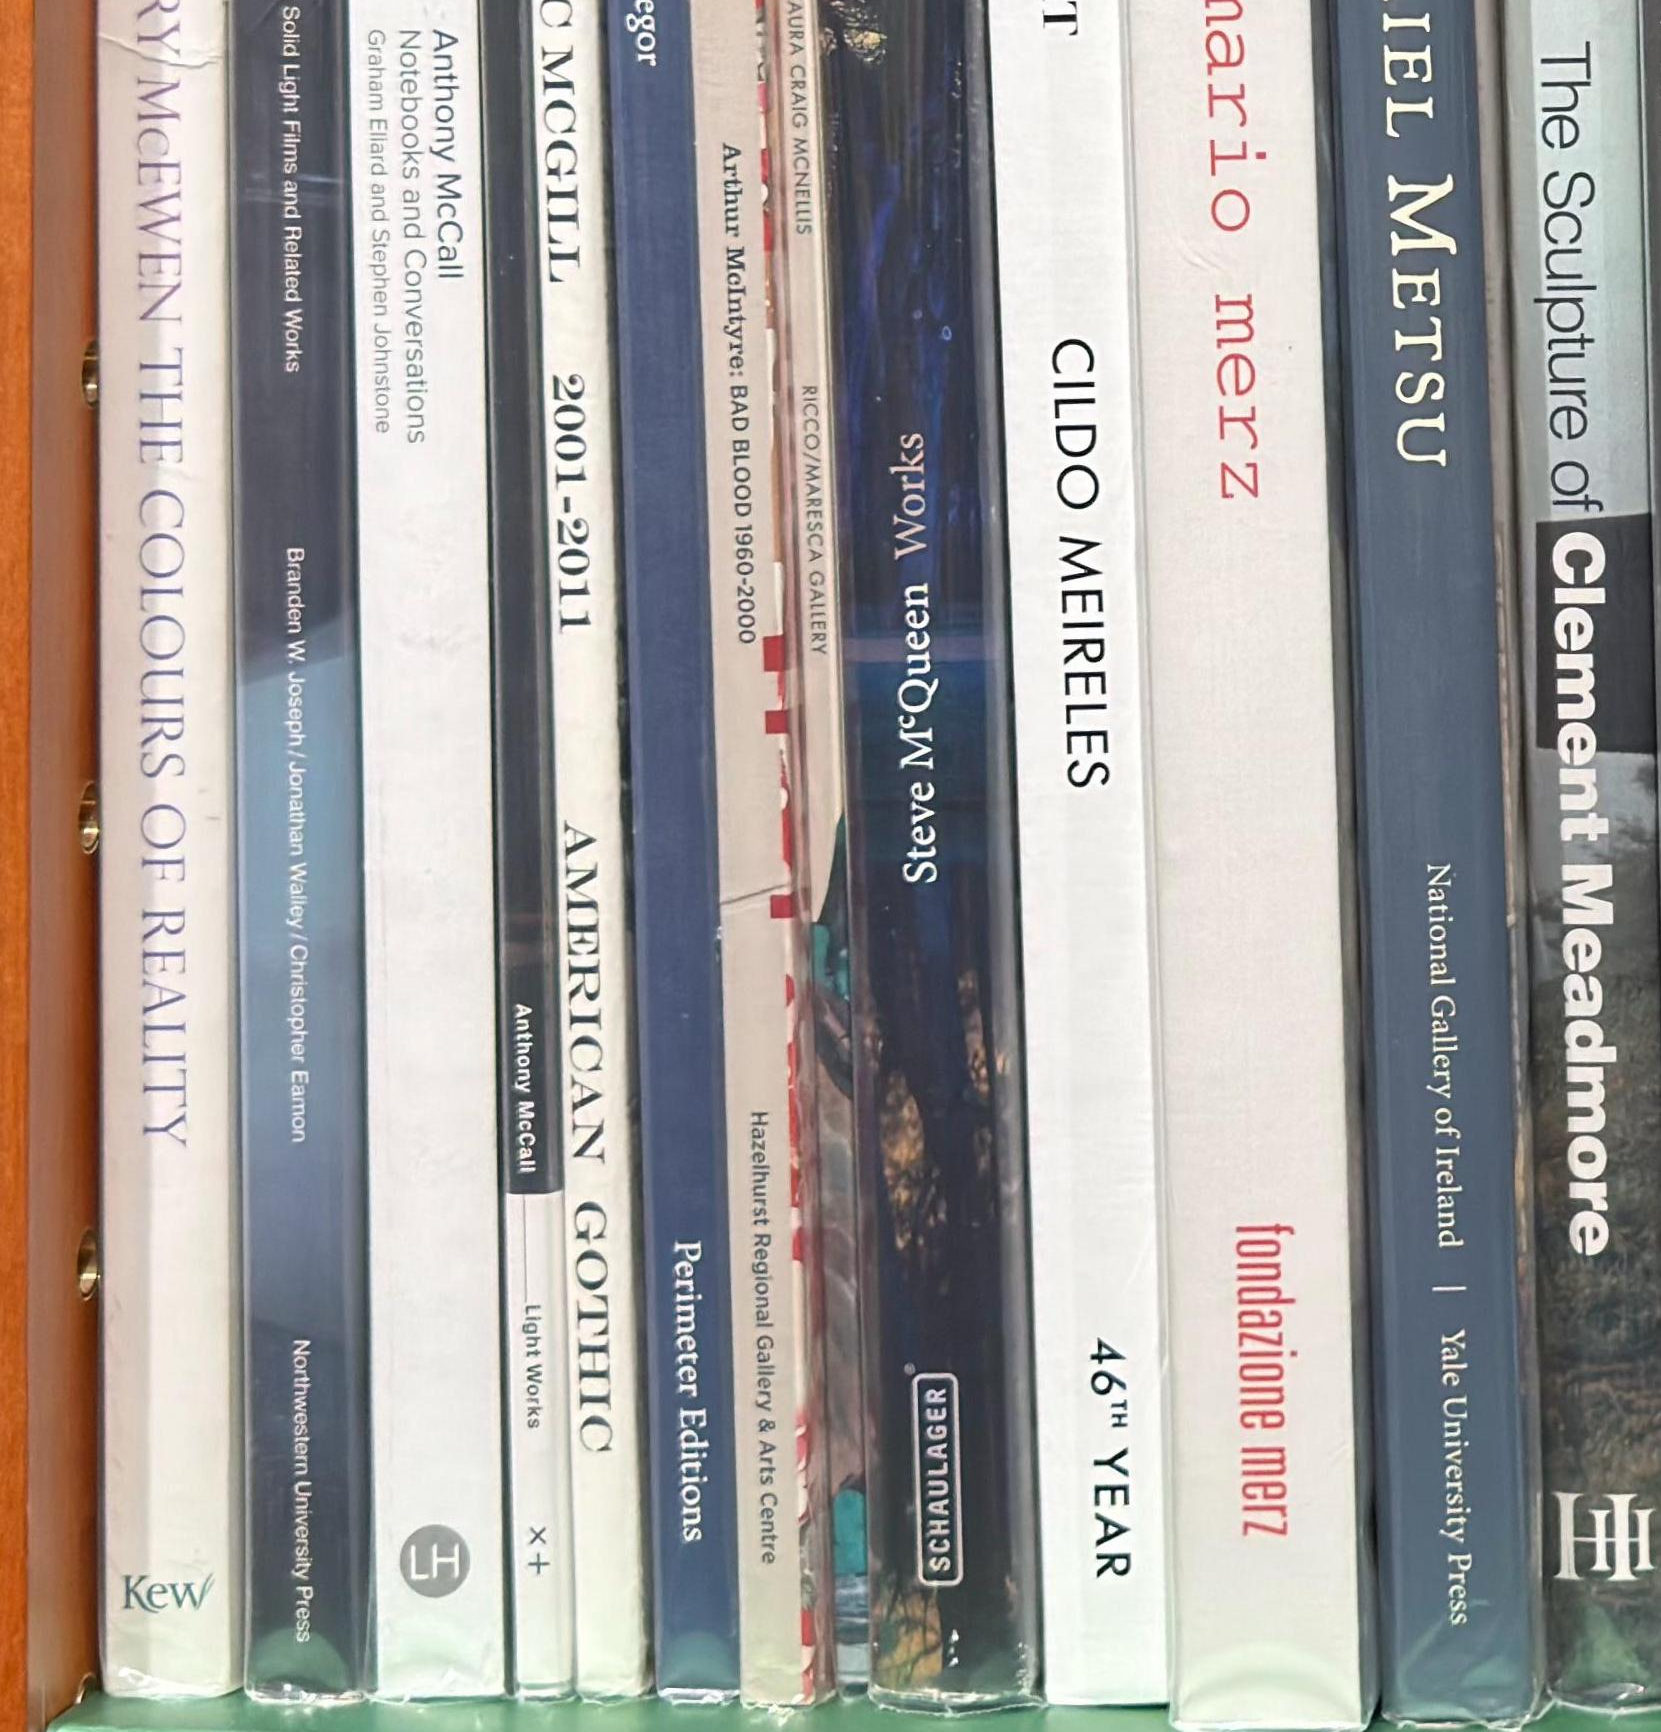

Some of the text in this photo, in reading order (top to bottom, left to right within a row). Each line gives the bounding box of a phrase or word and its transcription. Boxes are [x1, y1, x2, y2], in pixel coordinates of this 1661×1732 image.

[279, 64, 300, 112] Light
[283, 6, 301, 56] Solid
[283, 121, 301, 174] Films
[790, 65, 808, 128] CRAIG
[282, 180, 301, 218] and
[284, 226, 302, 302] Related
[368, 29, 392, 433] Graham Ellard and Stephen Johnstone
[399, 30, 429, 443] Notebooks and Conversations
[429, 29, 463, 278] Anthony McCall
[542, 46, 580, 282] MCGILL
[792, 138, 812, 234] MCNELLIS
[283, 309, 303, 372] Works
[723, 143, 756, 644] Arthur McIntyre: BAD BLOOD 1960-2000
[1216, 294, 1258, 499] merz
[1387, 174, 1453, 466] METSU
[1538, 41, 1606, 519] The Sculpture of
[138, 346, 185, 467] THE
[553, 374, 591, 630] 2001-2011
[802, 386, 827, 654] RICCO/MARESCA GALLERY
[139, 490, 185, 778] COLOURS
[285, 548, 306, 633] Branden
[287, 640, 306, 664] W.
[889, 433, 938, 884] Steve McQueen Works
[1052, 339, 1109, 787] CILDO MEIRELES
[140, 804, 185, 881] OF
[1549, 532, 1614, 1256] Clement Meadmore
[141, 909, 187, 1145] REALITY
[513, 1004, 536, 1173] Anthony McCall
[564, 820, 612, 1451] AMERICAN GOTHIC
[1426, 864, 1464, 1247] National Gallery of Ireland
[521, 1305, 542, 1428] Light Works
[674, 1241, 708, 1543] Perimeter Editions
[751, 1112, 778, 1564] Hazelhurst Regional Gallery & Arts Centre
[1090, 1338, 1131, 1578] 46TH YEAR
[1235, 1224, 1295, 1536] fondazione merz
[121, 1572, 216, 1614] Kew
[291, 1340, 313, 1643] Northwestern University Press
[925, 1387, 951, 1572] SCHAULAGER
[1439, 1329, 1472, 1625] Yale University Press
